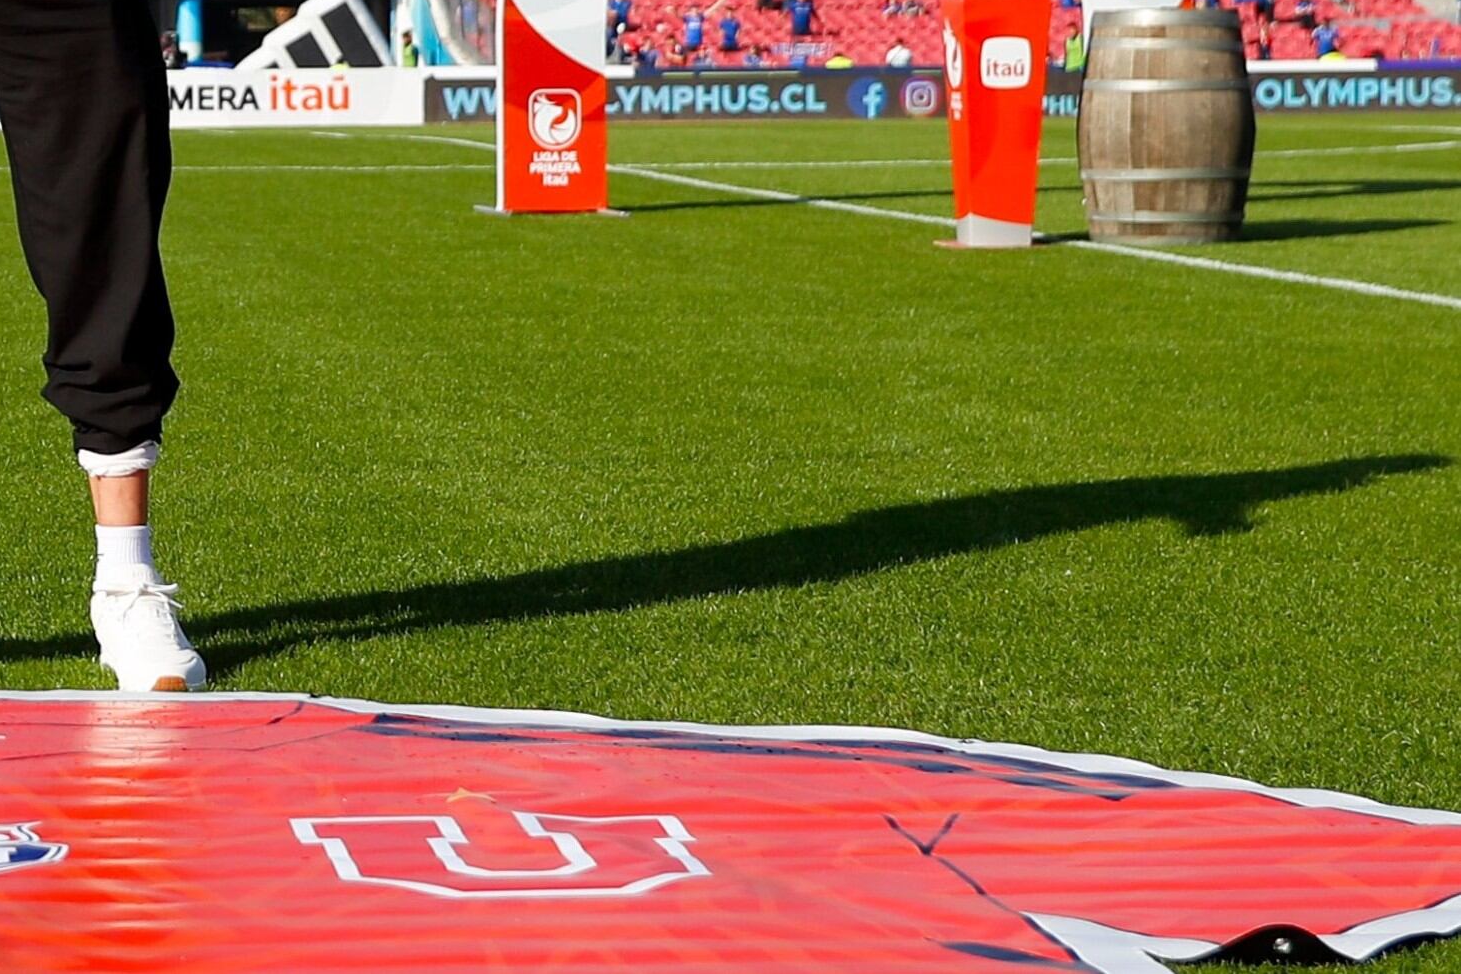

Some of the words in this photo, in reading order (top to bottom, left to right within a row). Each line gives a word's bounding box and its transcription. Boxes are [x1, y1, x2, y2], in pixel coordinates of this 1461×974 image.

[985, 58, 1026, 77] itaú
[268, 74, 351, 112] itaú
[533, 150, 559, 162] LIGA
[560, 150, 578, 162] DE
[529, 161, 582, 174] PRIMERA
